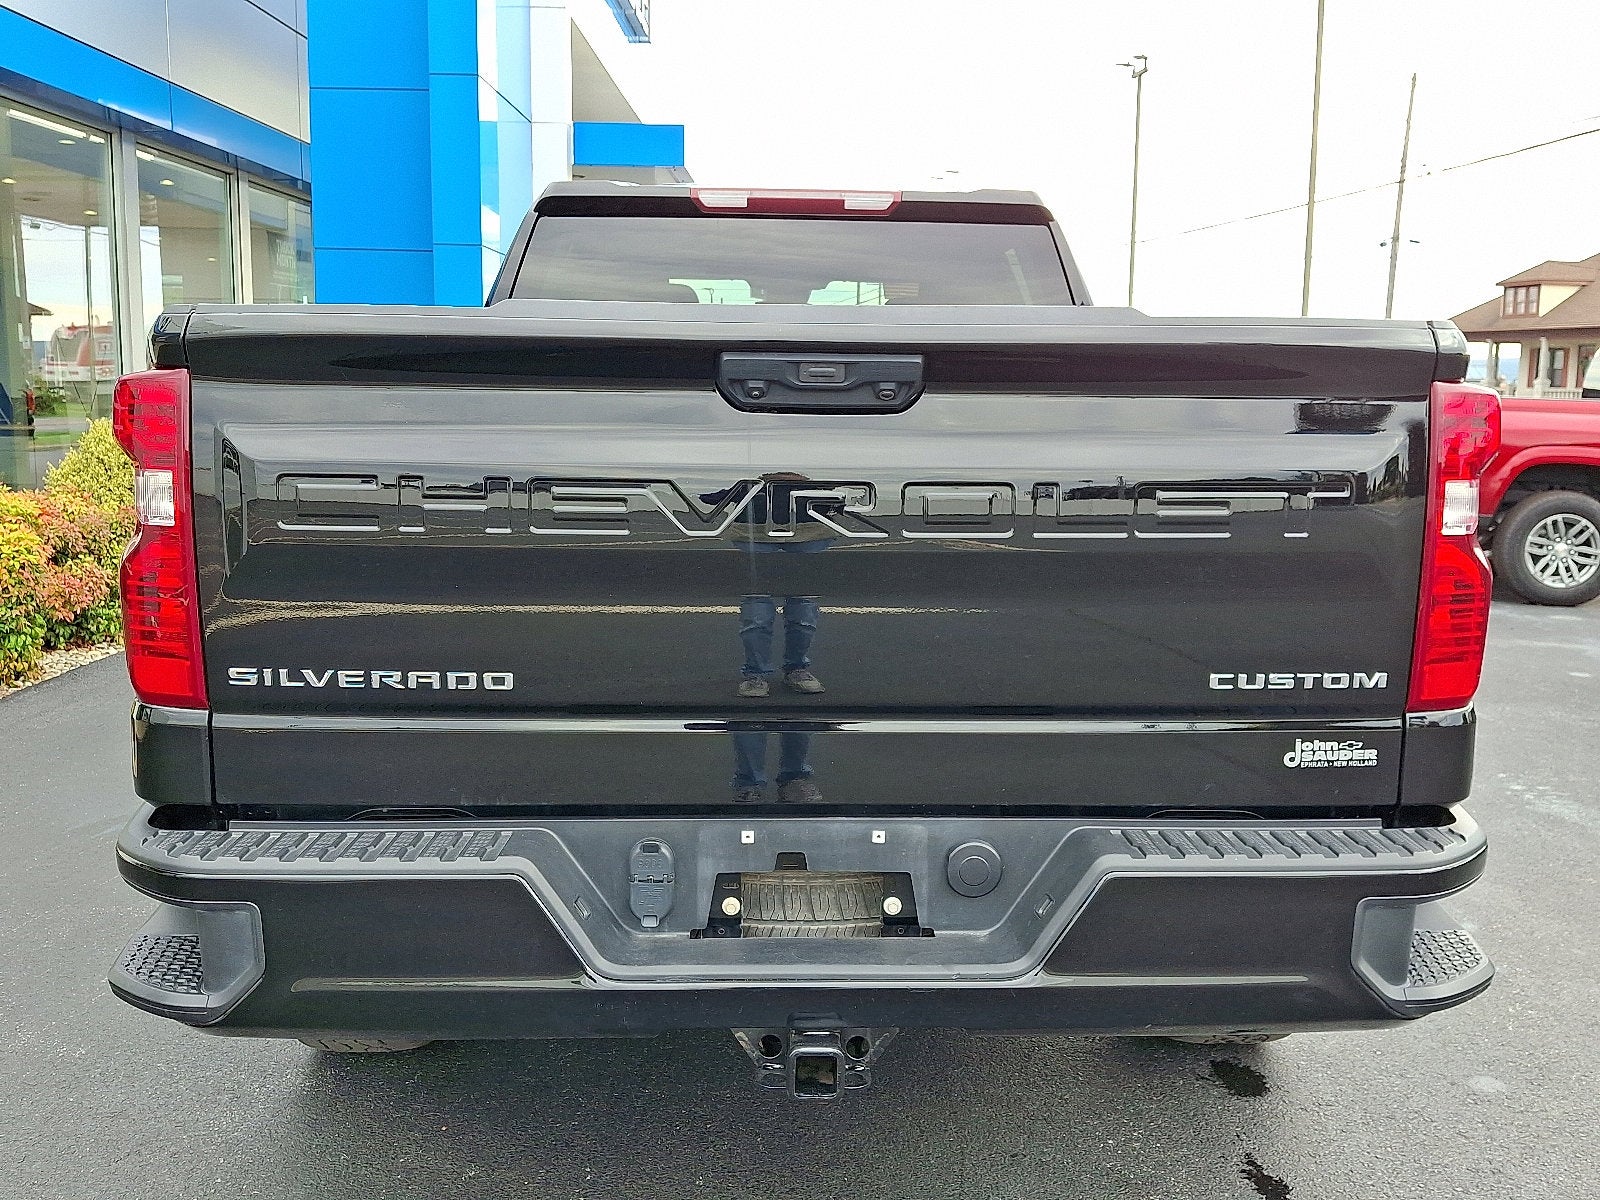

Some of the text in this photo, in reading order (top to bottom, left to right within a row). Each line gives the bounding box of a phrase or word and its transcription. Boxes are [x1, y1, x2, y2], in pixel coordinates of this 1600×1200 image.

[276, 474, 1355, 538] CHEVROLET
[227, 667, 514, 690] SILVERADO
[1208, 672, 1389, 690] CUSTOM
[1301, 749, 1378, 762] SAUDER
